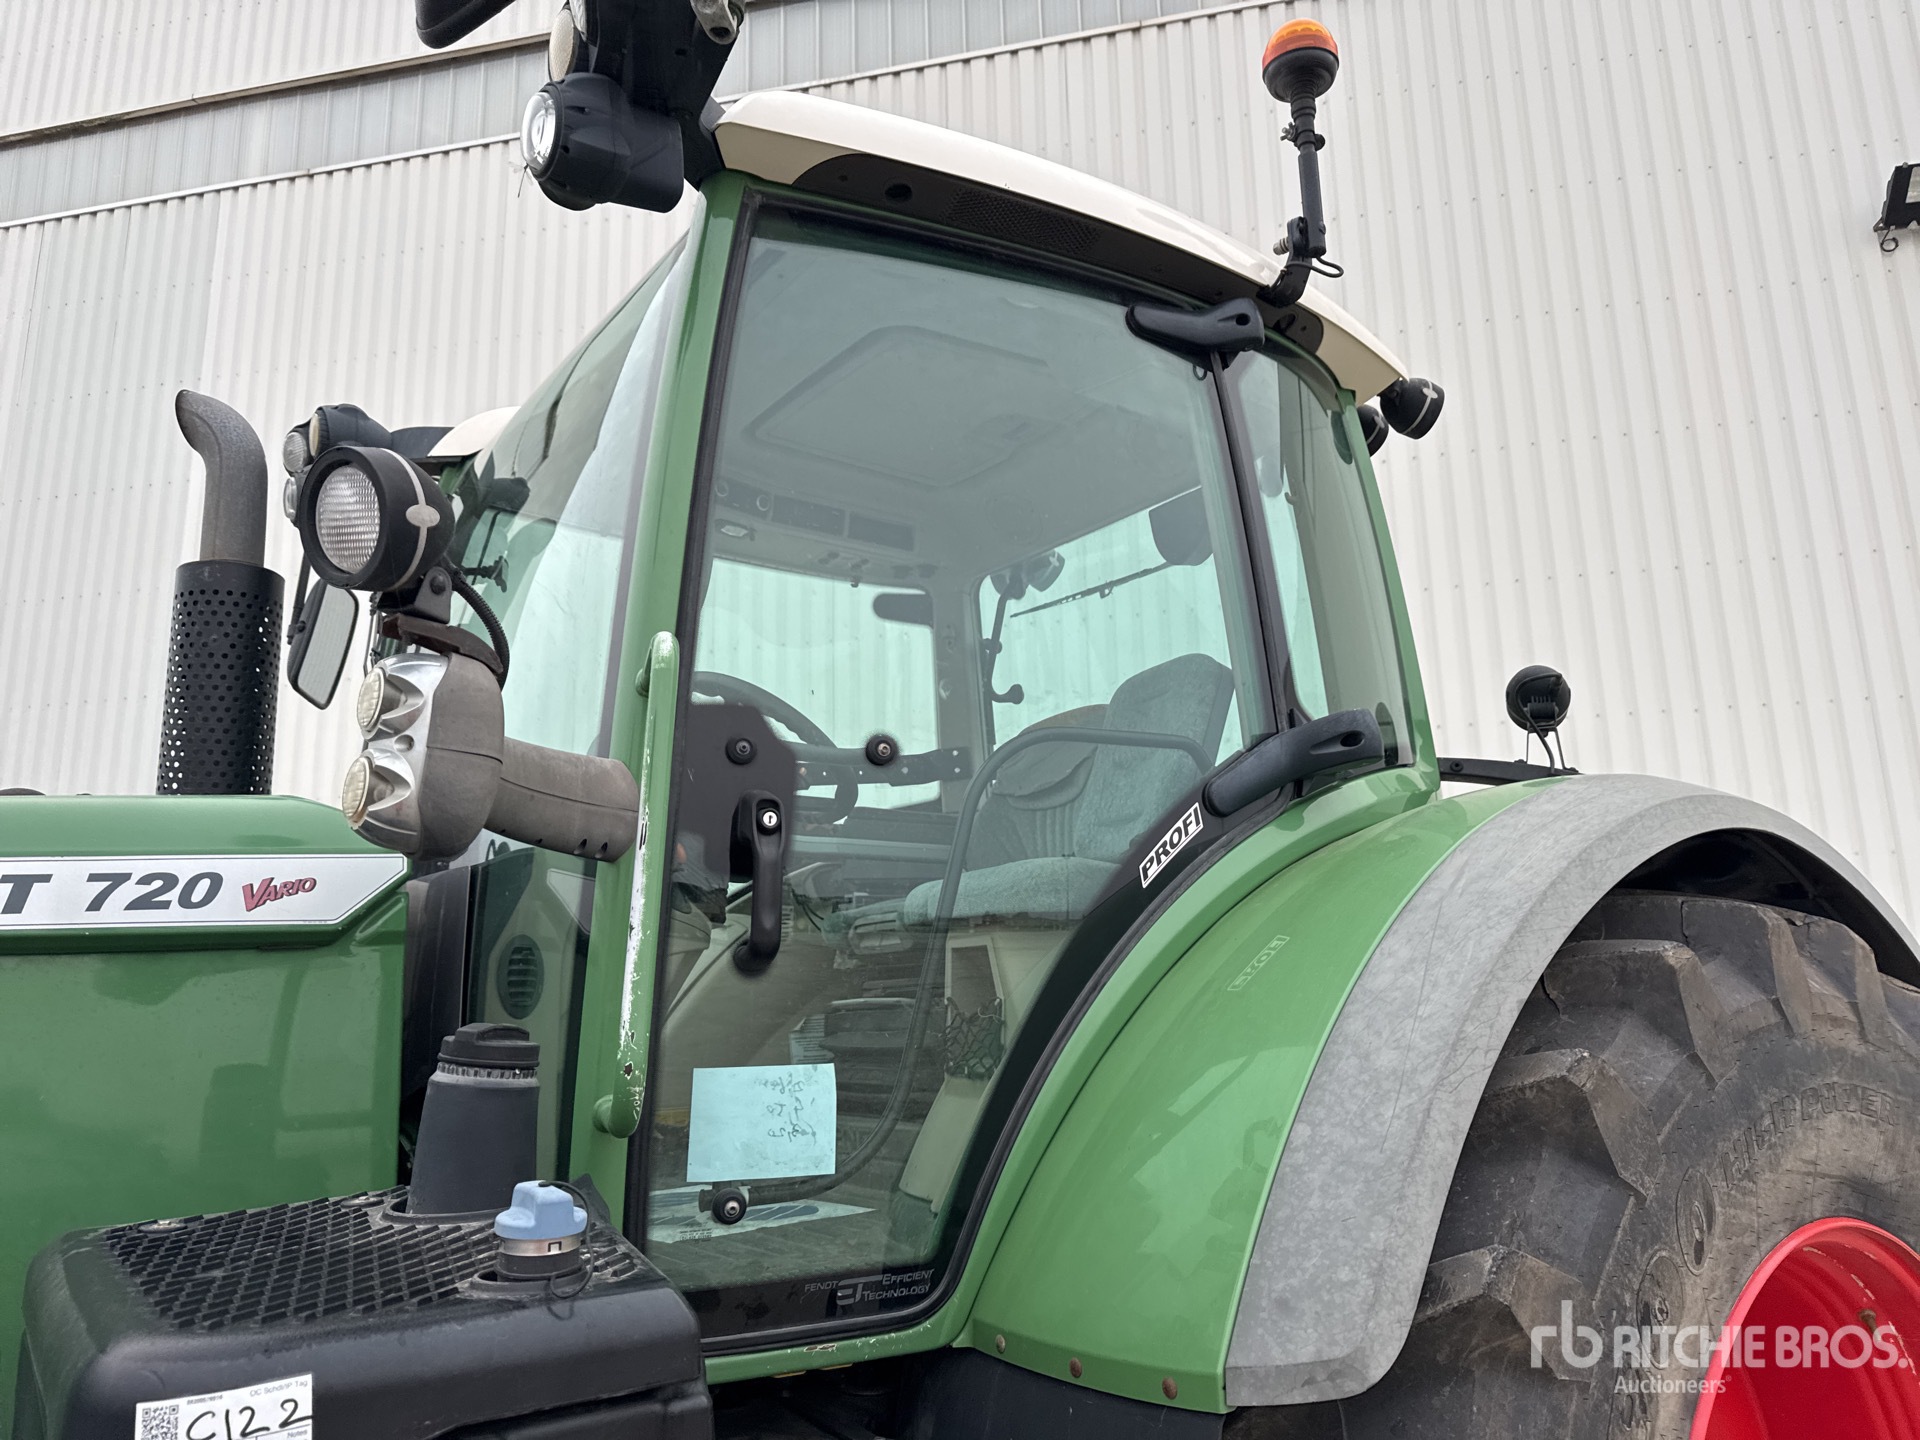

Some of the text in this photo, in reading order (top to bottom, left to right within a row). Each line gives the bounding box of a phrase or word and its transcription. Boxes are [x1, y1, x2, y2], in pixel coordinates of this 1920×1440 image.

[1141, 806, 1201, 882] PROFI
[84, 871, 224, 912] 720
[805, 1281, 838, 1292] FENDT
[295, 1380, 308, 1388] Tag
